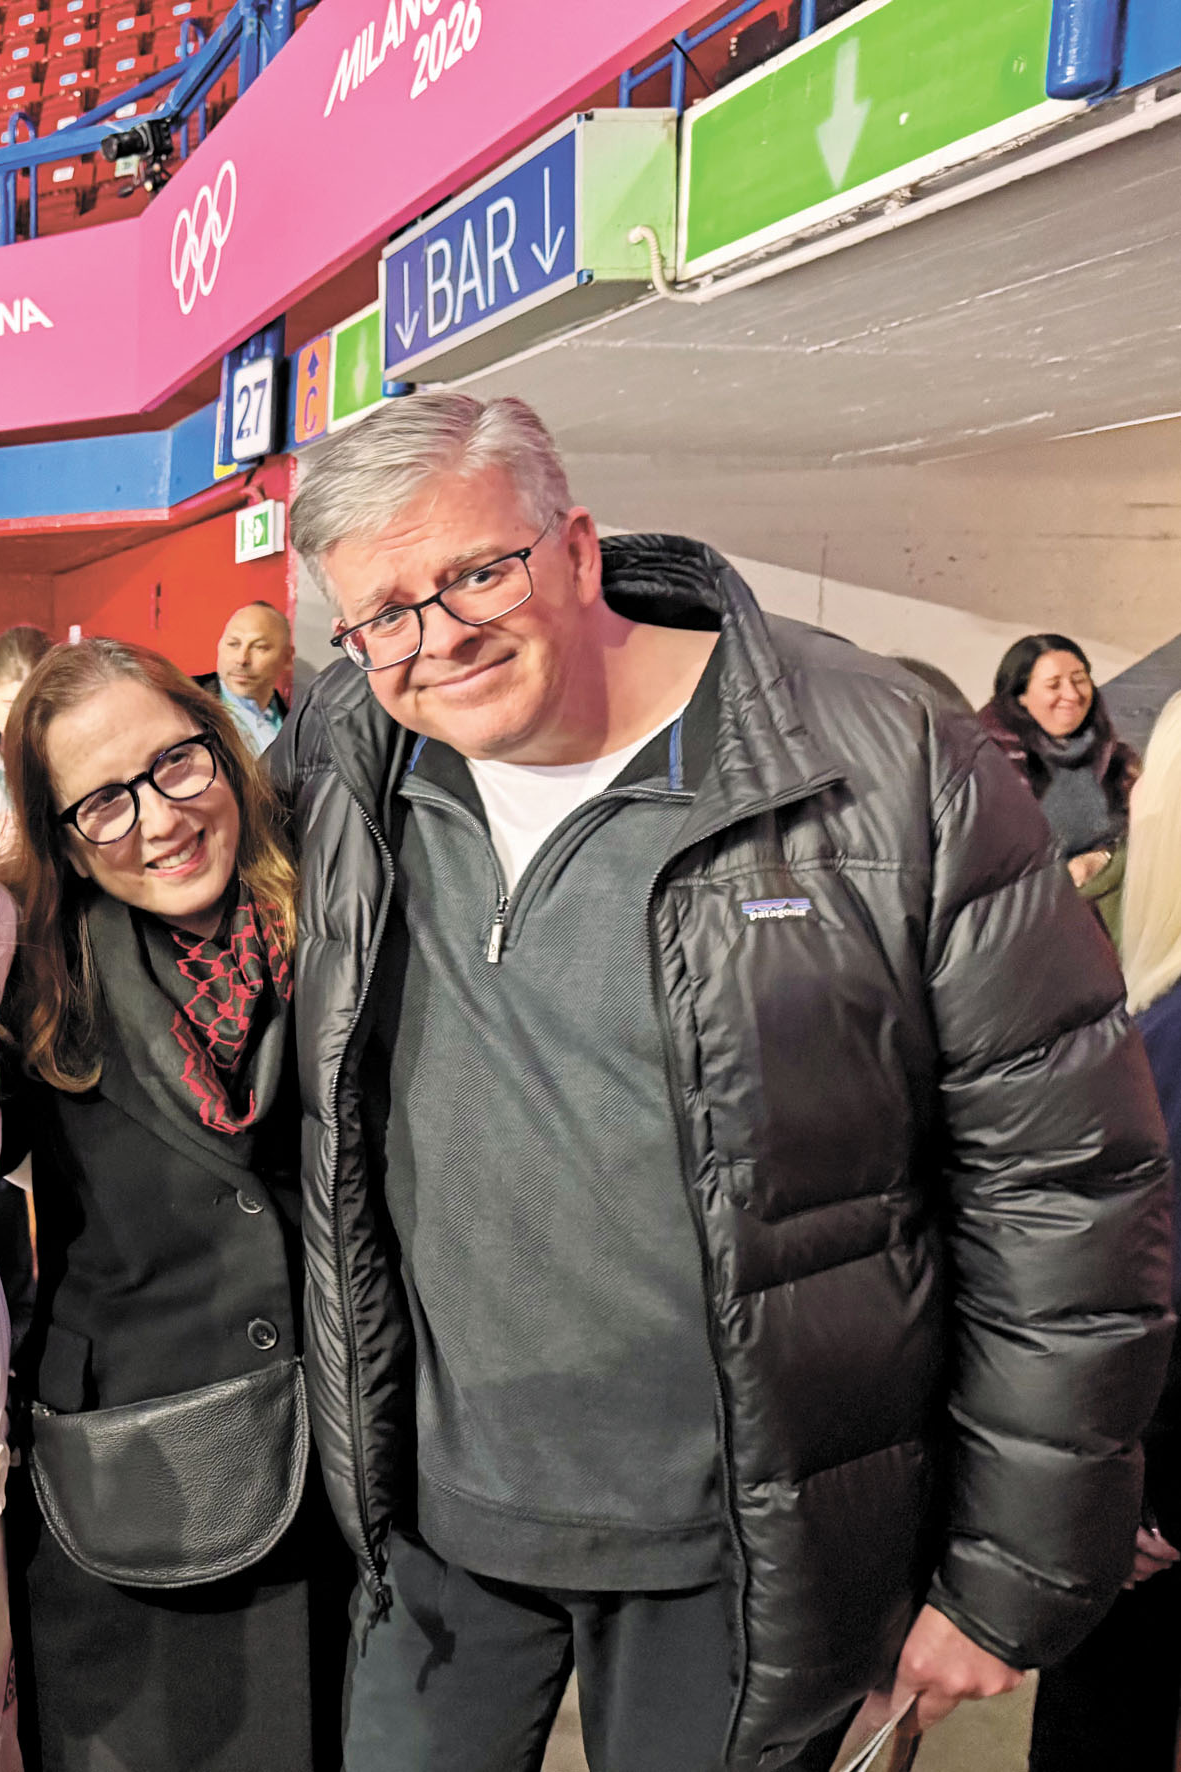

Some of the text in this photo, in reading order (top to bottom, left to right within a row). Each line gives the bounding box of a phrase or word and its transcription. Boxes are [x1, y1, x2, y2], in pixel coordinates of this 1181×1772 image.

[410, 0, 482, 99] 2026
[426, 196, 520, 338] BAR
[236, 378, 268, 440] 27
[304, 386, 318, 432] C
[749, 908, 807, 920] patagonia
